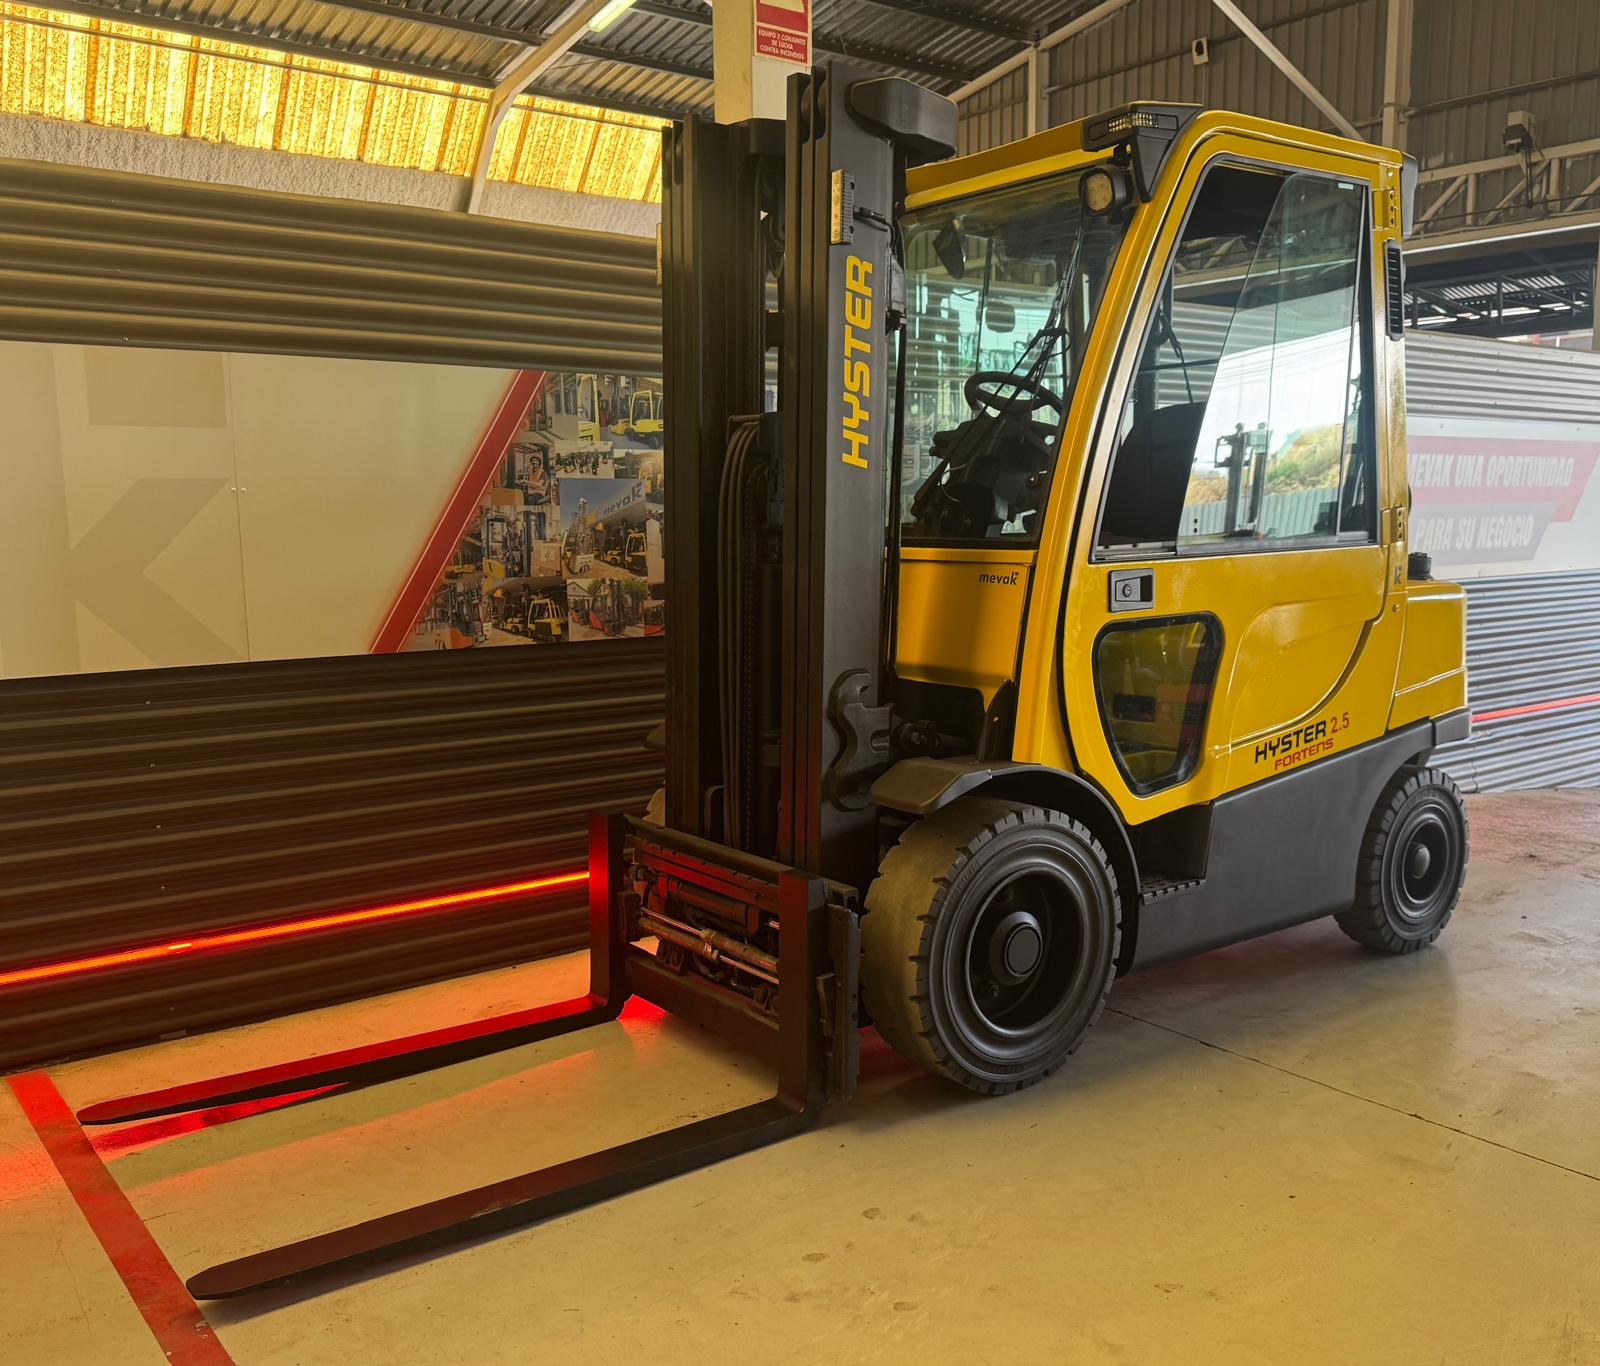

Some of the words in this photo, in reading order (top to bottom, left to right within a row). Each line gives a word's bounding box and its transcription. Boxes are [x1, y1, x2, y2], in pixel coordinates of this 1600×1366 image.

[759, 29, 776, 38] EQUIPO
[779, 41, 793, 50] LUCHA
[760, 45, 779, 53] CONTRA
[780, 49, 804, 60] INCENDIOS
[842, 255, 873, 469] HYSTER
[1454, 454, 1484, 488] UNA
[1486, 455, 1575, 488] OPORTUNIDAD
[1413, 516, 1454, 551] PARA
[1456, 516, 1477, 549] SU
[1476, 514, 1535, 549] NEGOCIO
[979, 571, 1020, 586] mevak
[1254, 719, 1327, 764] HYSTER
[1330, 711, 1350, 734] 2.5
[1274, 737, 1334, 771] FORTENS
